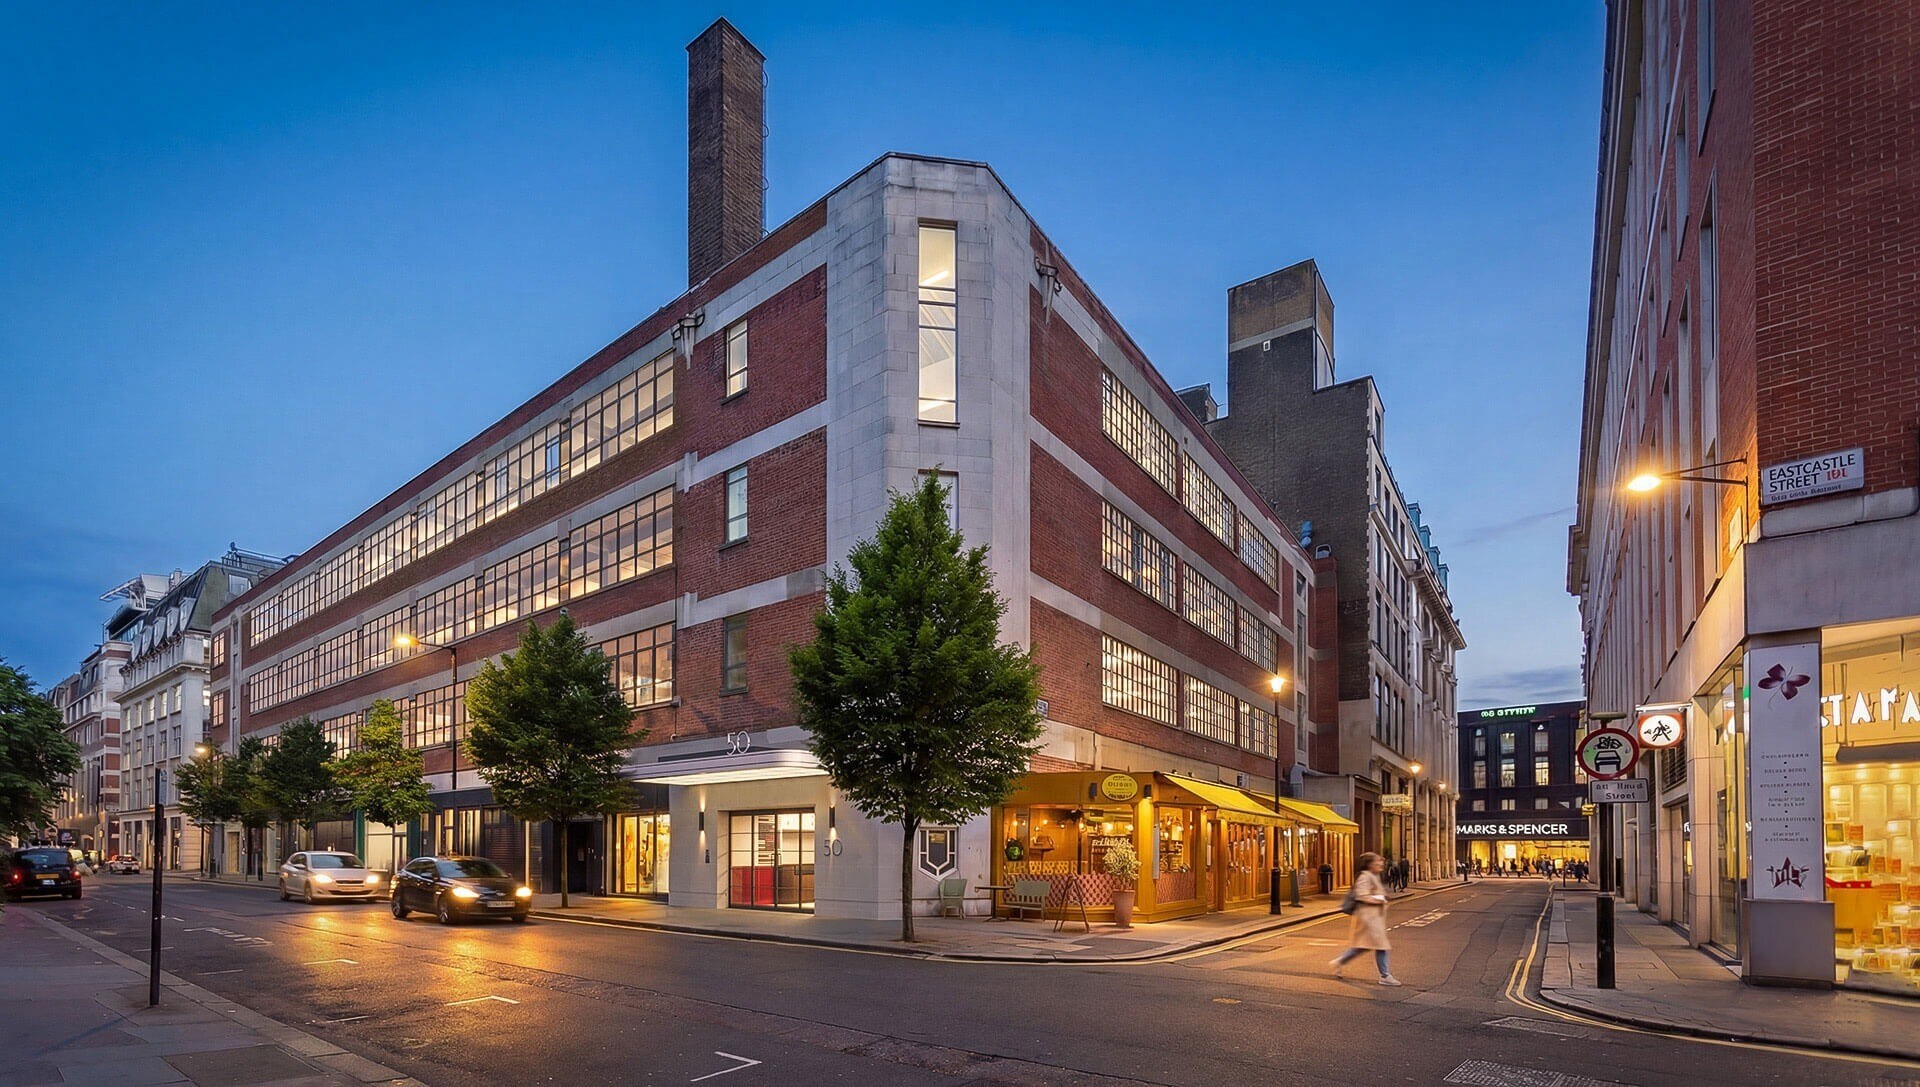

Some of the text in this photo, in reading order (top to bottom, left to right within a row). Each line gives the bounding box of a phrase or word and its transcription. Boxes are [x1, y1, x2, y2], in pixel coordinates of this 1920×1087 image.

[1769, 454, 1856, 481] EASTCASTLE
[1769, 473, 1820, 493] STREET
[726, 730, 751, 756] 50
[1456, 824, 1568, 835] MARKS & SPENCER
[823, 839, 843, 857] 50
